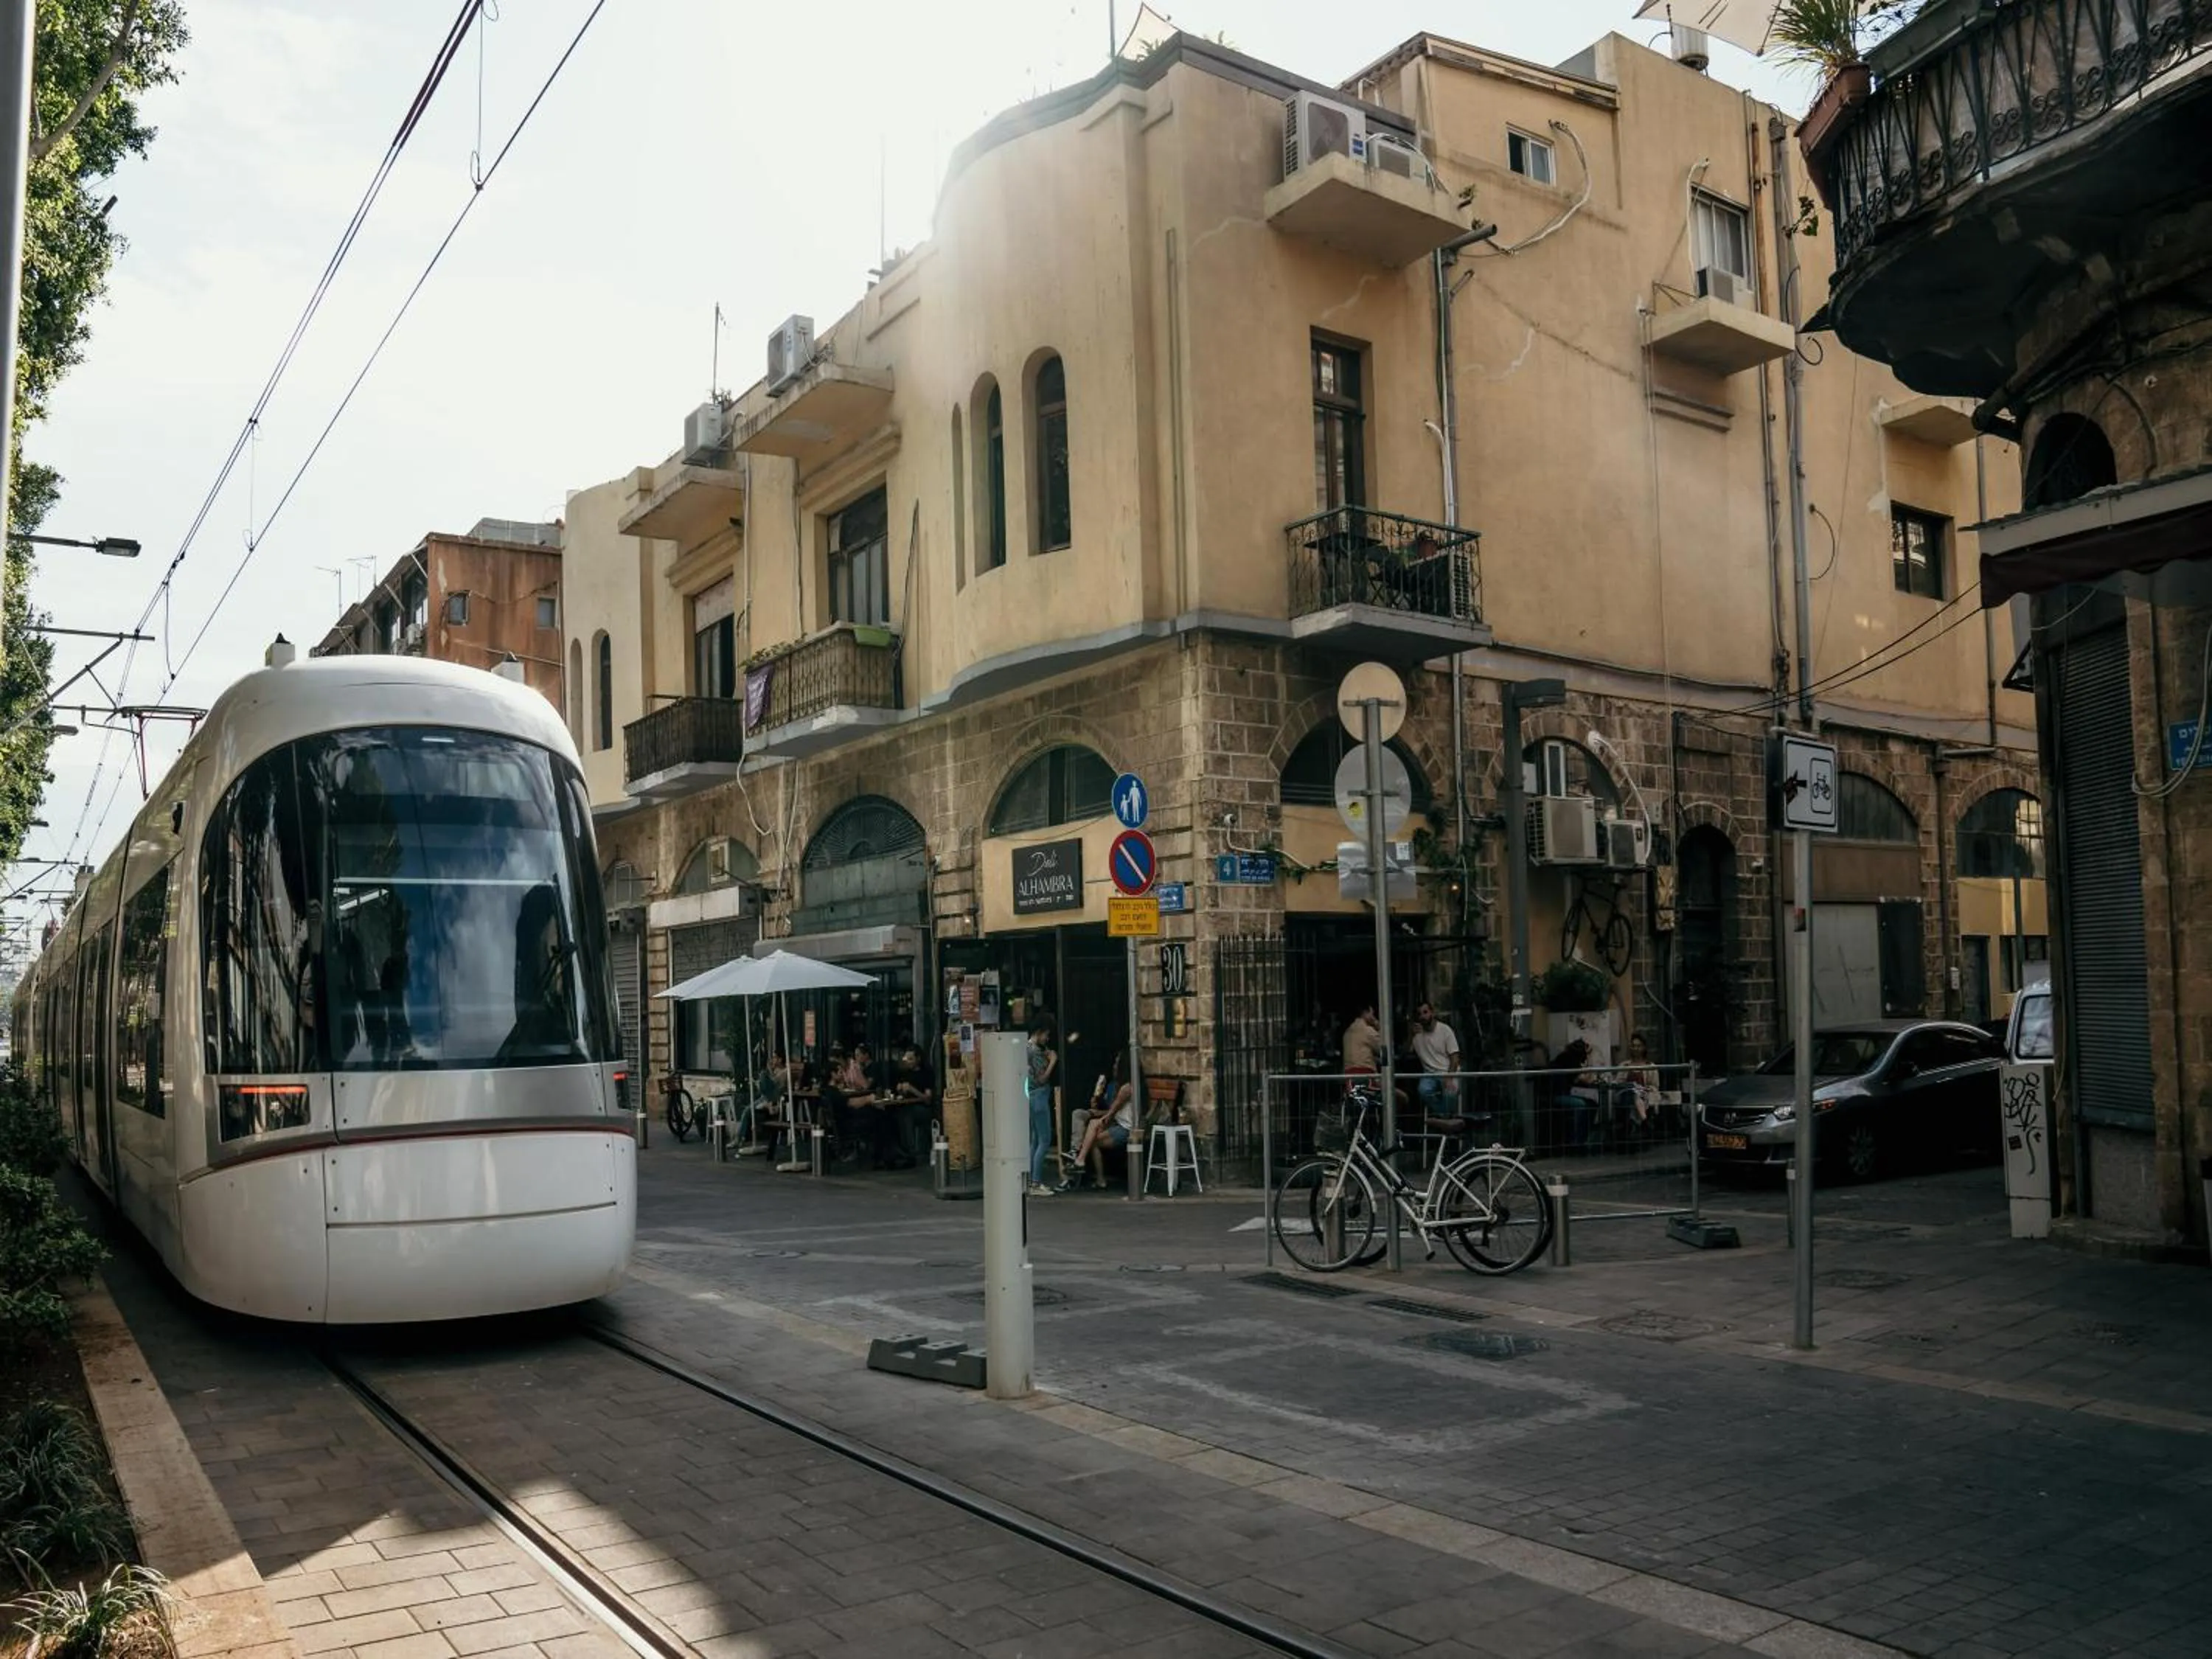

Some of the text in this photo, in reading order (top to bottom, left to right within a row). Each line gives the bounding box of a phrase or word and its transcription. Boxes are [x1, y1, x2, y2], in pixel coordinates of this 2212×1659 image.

[1223, 860, 1231, 877] 4
[1018, 874, 1074, 896] ALHAMBRA
[1163, 946, 1182, 992] 30
